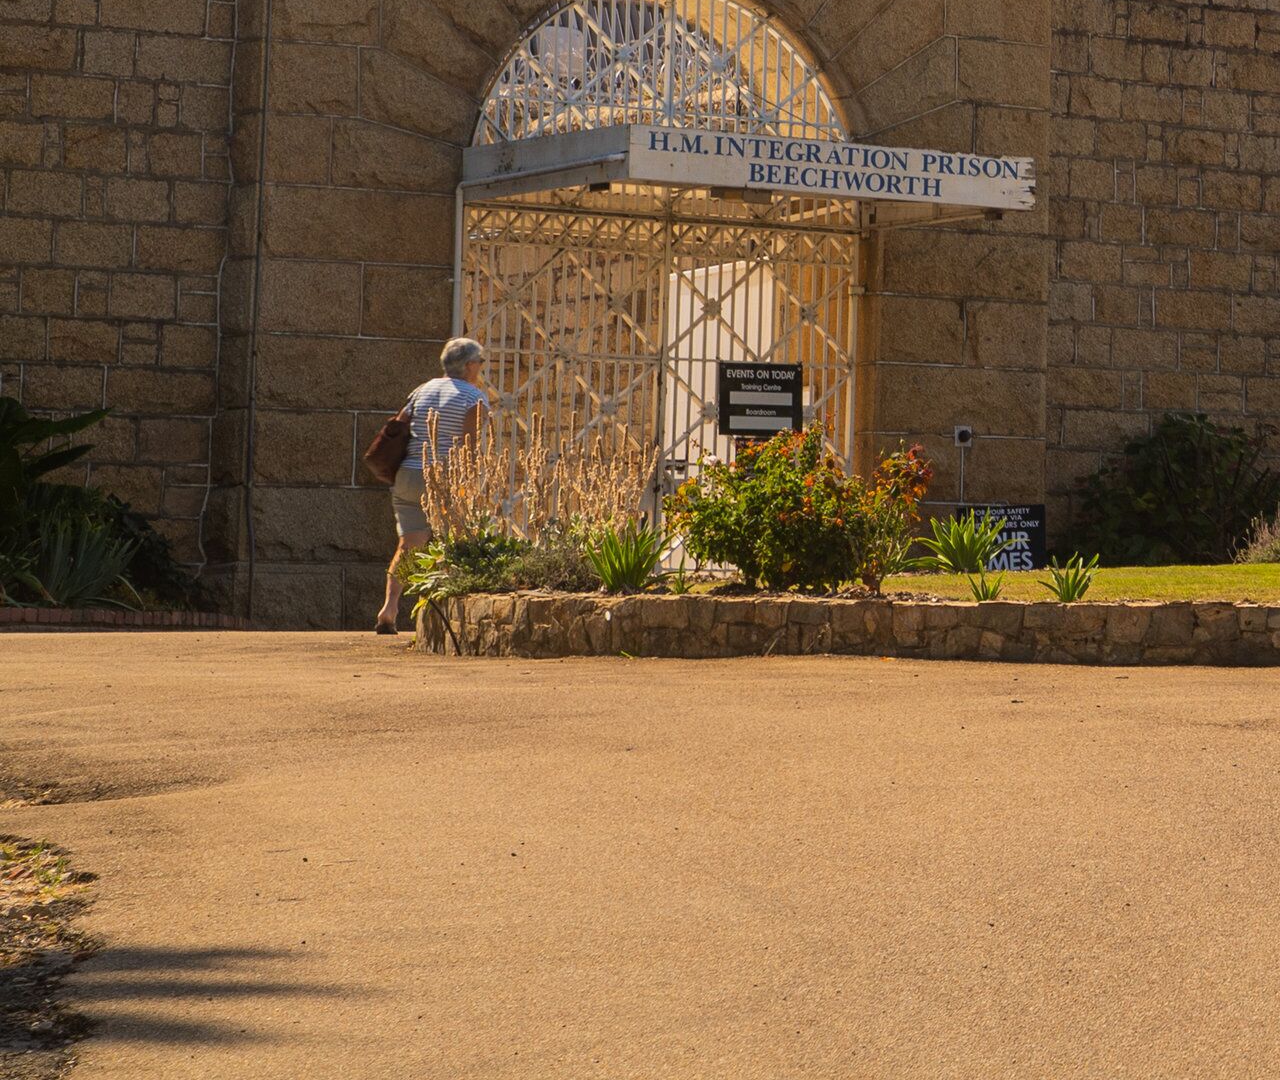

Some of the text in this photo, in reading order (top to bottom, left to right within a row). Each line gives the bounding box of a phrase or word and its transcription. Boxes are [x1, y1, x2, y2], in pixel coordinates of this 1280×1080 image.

[648, 131, 1020, 180] H.M. INTEGRATION PRISON
[748, 162, 944, 197] BEECHWORTH
[726, 369, 796, 380] EVENTS ON TODAY
[741, 383, 763, 391] Training
[745, 408, 776, 416] Boardroom
[1020, 520, 1040, 528] ONLY
[988, 551, 1034, 571] MES
